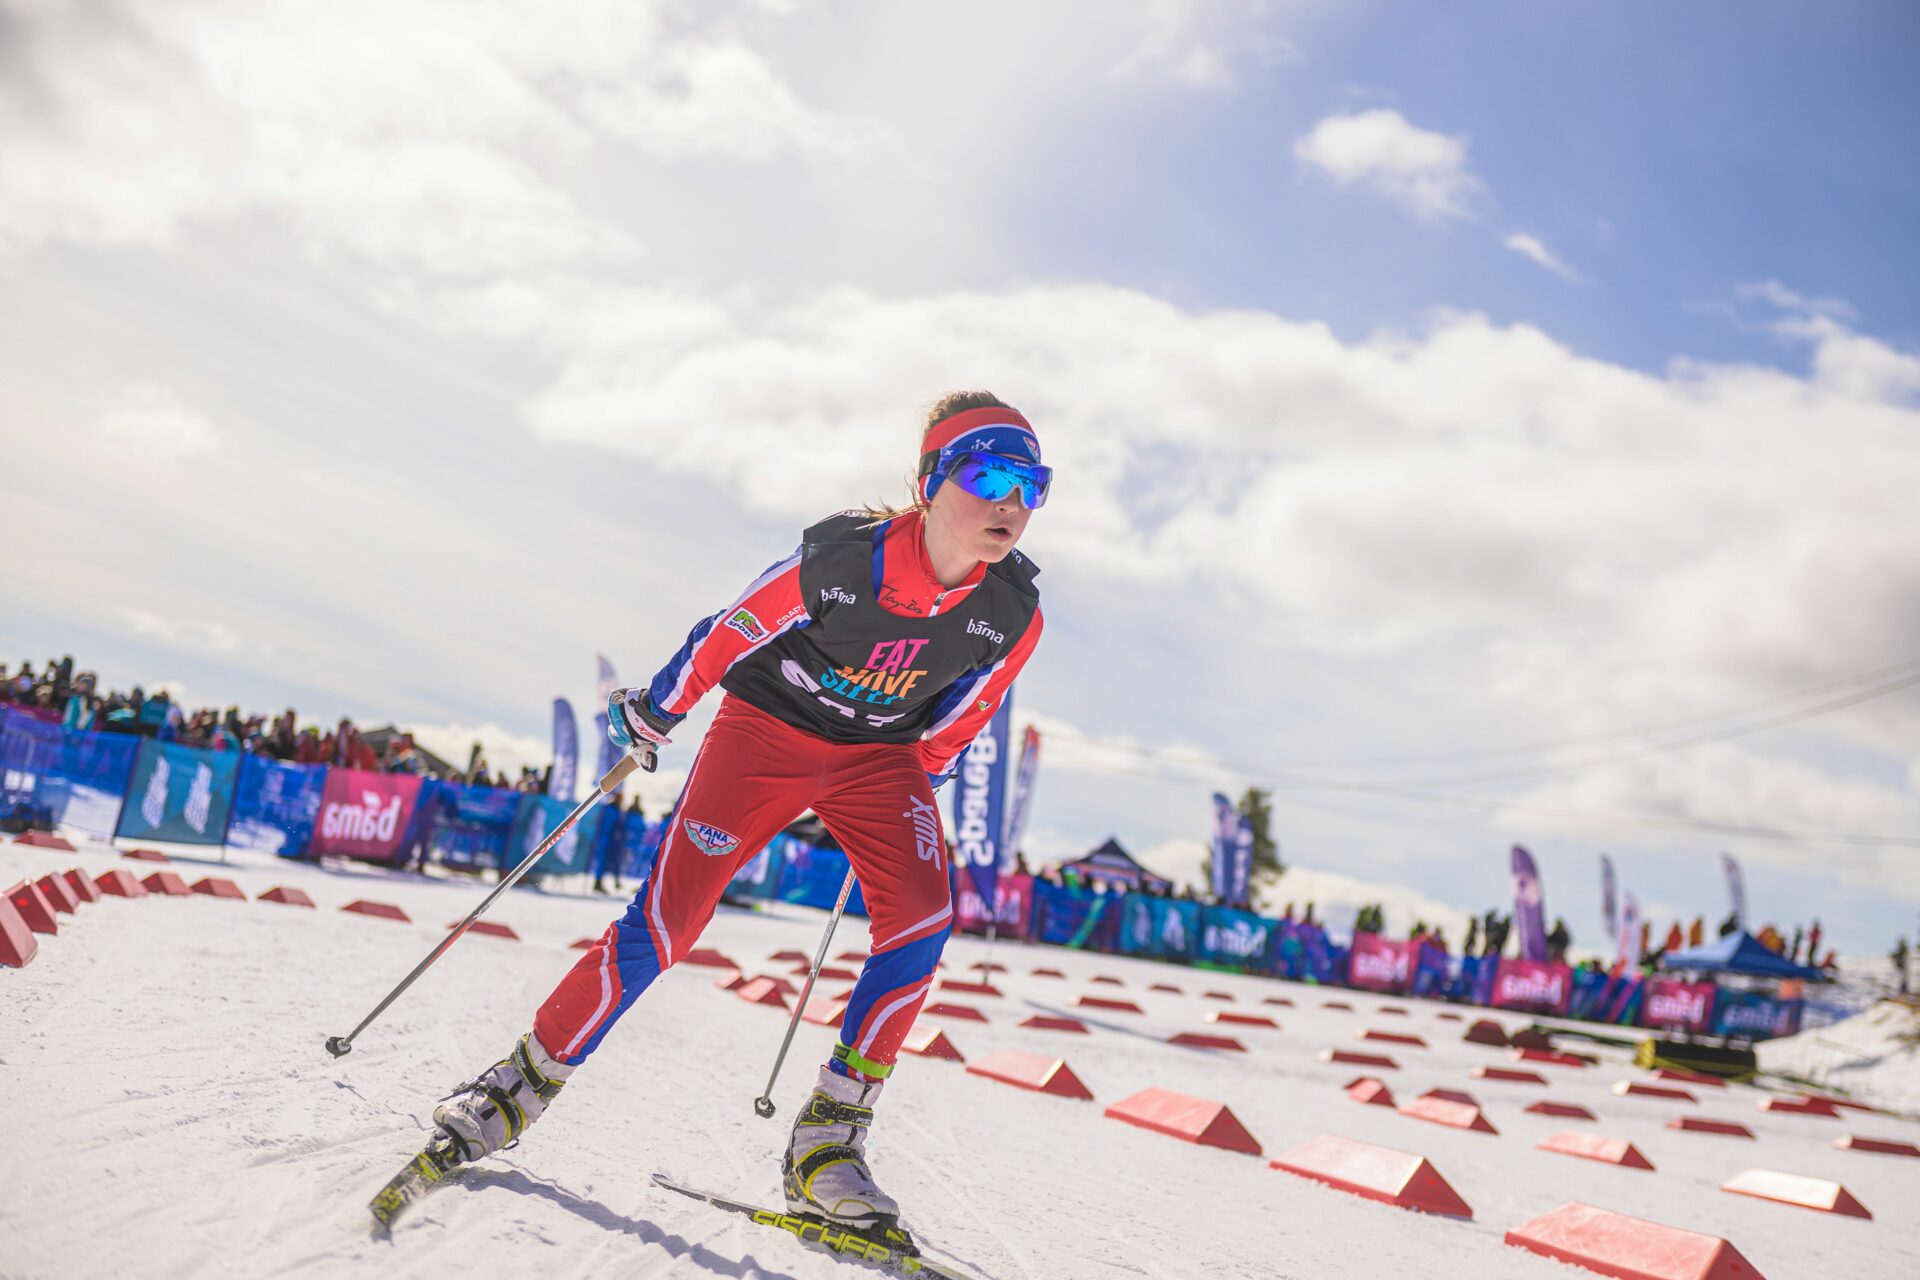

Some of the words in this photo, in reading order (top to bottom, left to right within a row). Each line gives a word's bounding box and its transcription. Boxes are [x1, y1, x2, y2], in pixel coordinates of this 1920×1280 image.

[727, 620, 758, 641] SPORT
[865, 638, 930, 675] EAT
[834, 665, 928, 699] MOVE
[699, 825, 728, 844] FANA
[707, 835, 717, 847] IL
